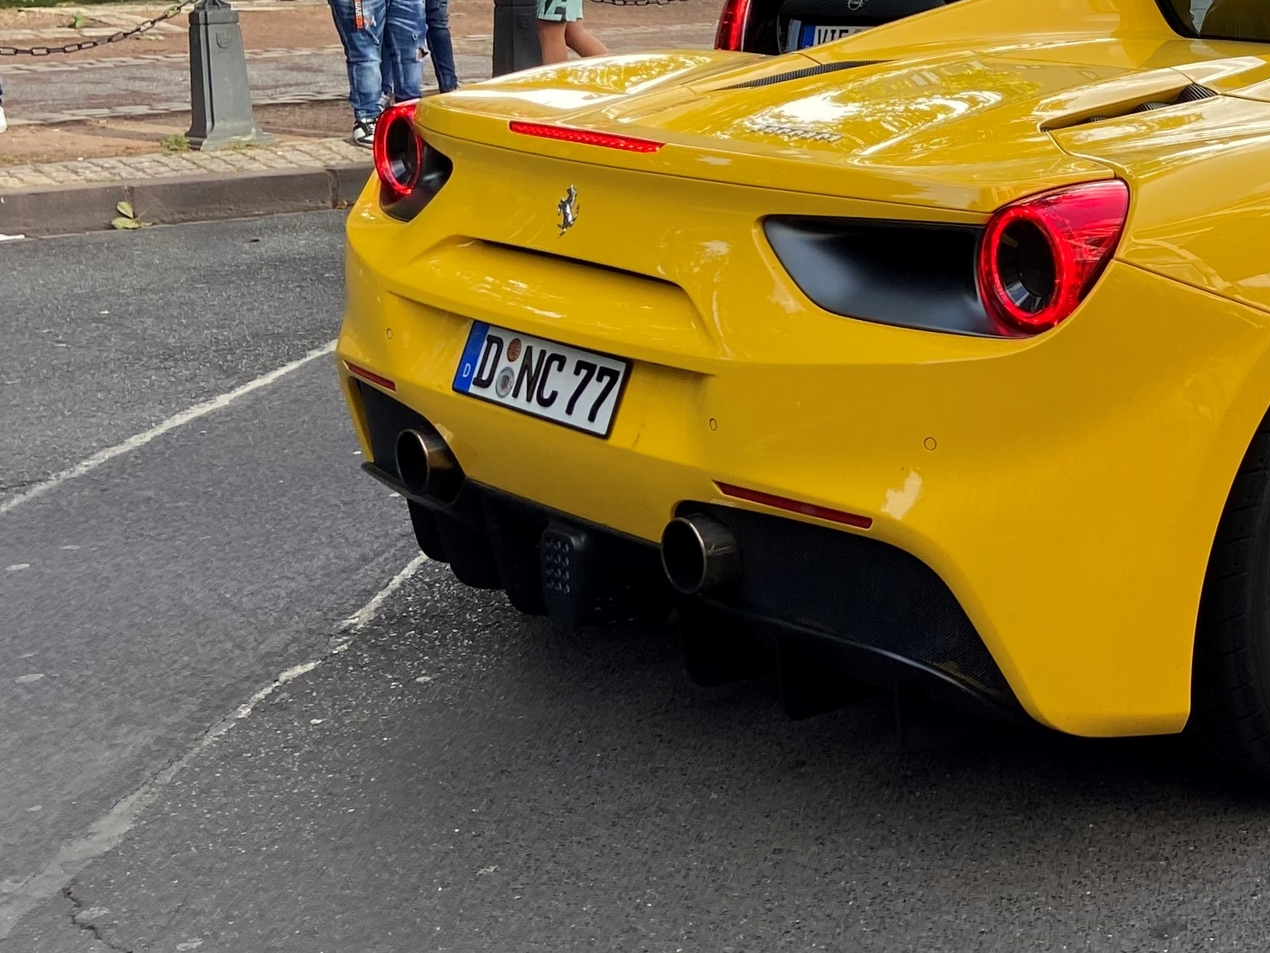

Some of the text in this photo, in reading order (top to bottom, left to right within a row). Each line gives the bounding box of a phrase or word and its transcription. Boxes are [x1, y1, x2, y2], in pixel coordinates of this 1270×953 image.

[472, 334, 504, 388] D
[511, 345, 567, 408] NC
[565, 359, 621, 423] 77
